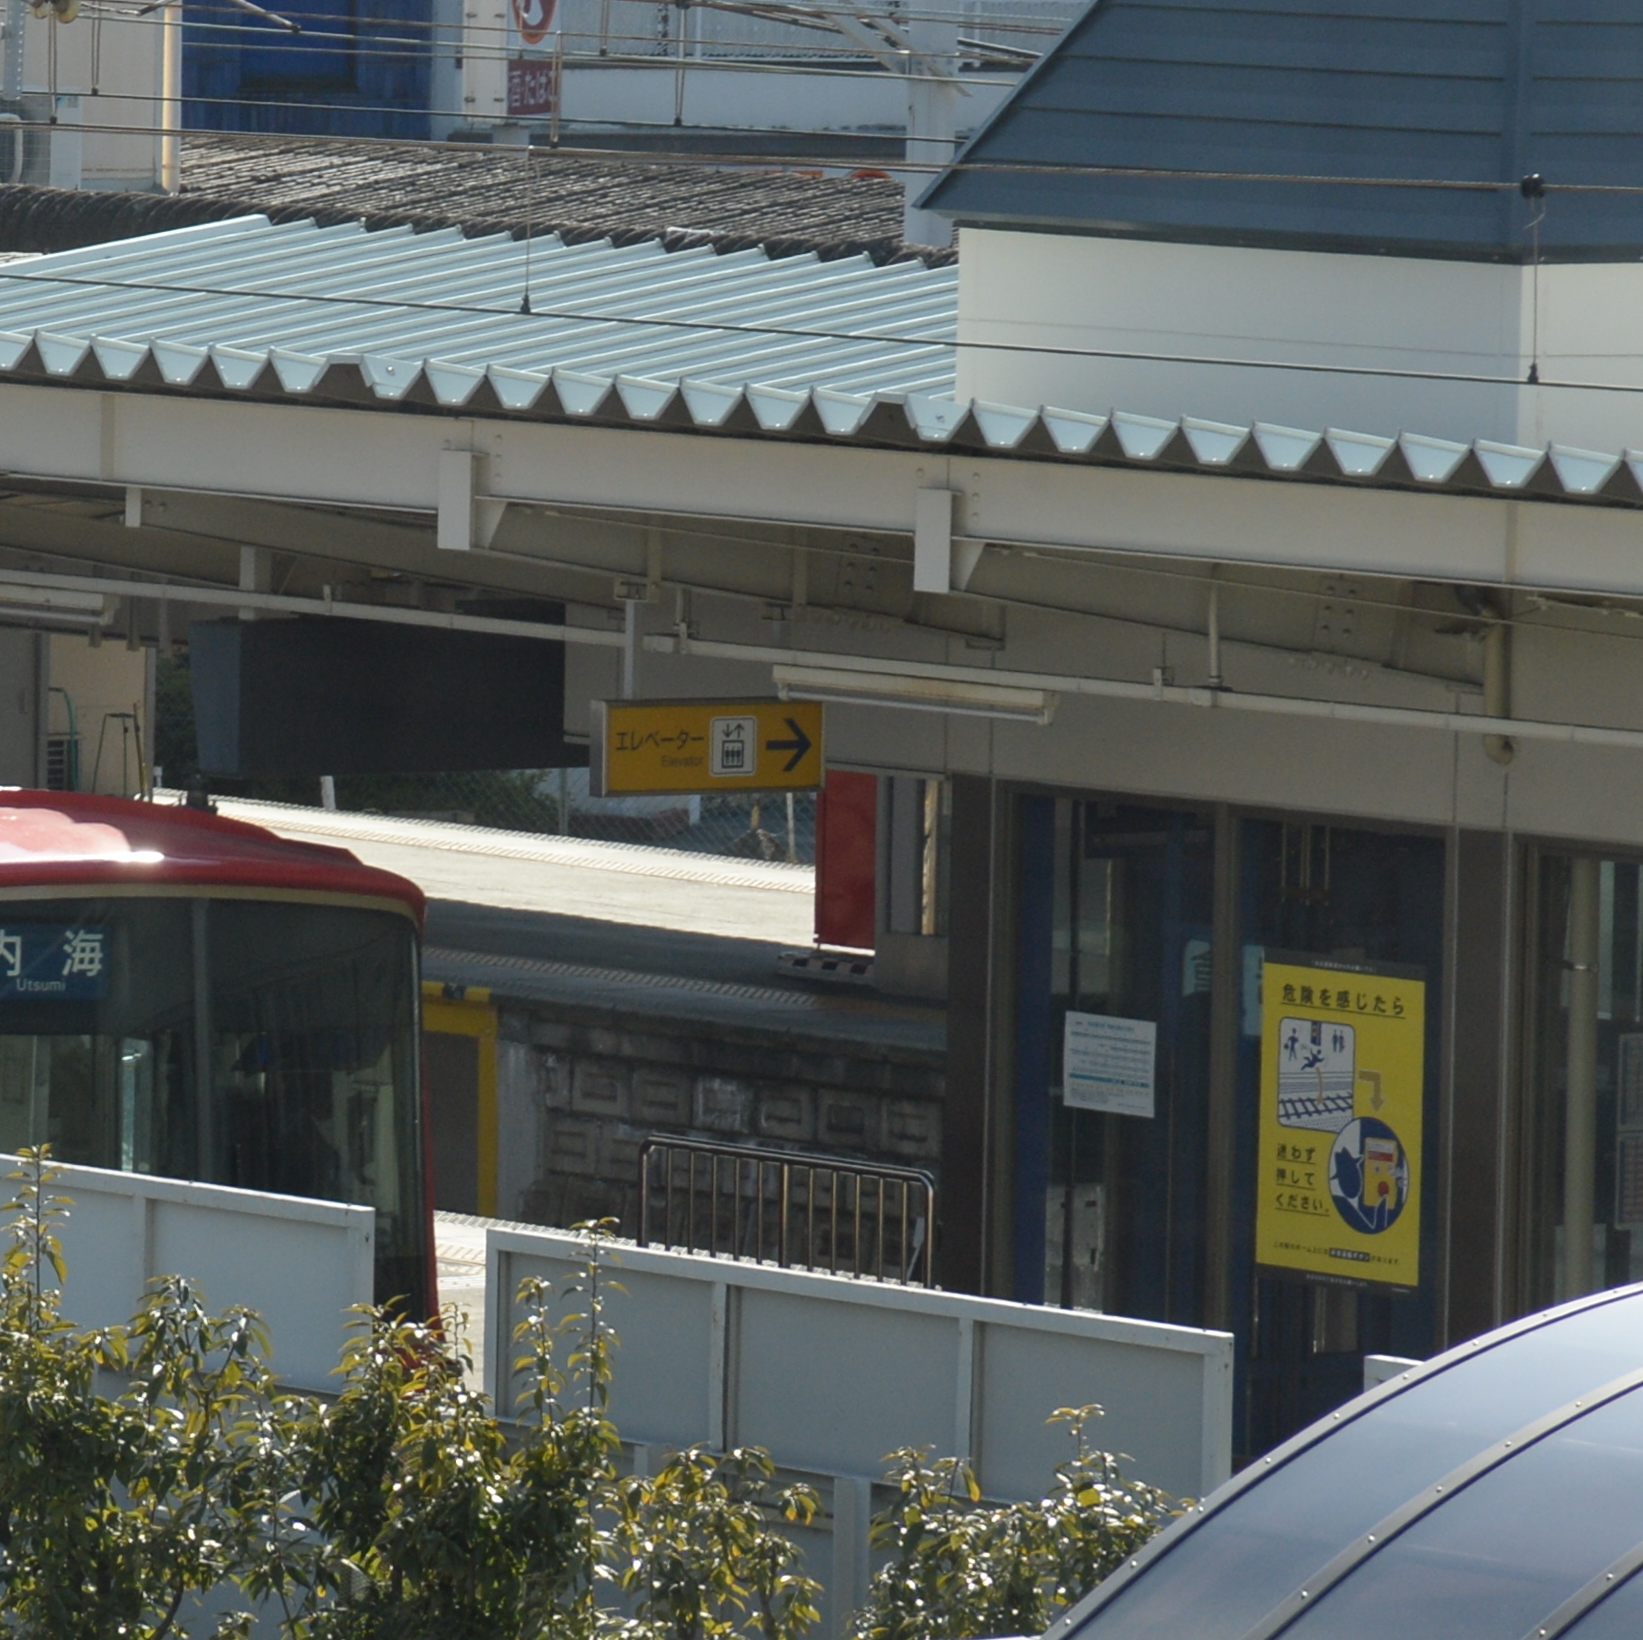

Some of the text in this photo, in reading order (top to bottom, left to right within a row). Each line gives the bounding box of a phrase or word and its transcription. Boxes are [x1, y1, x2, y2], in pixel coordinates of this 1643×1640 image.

[616, 728, 705, 751] エレベーター
[16, 978, 66, 992] Utsumi
[1282, 983, 1404, 1015] 危険を感じたら
